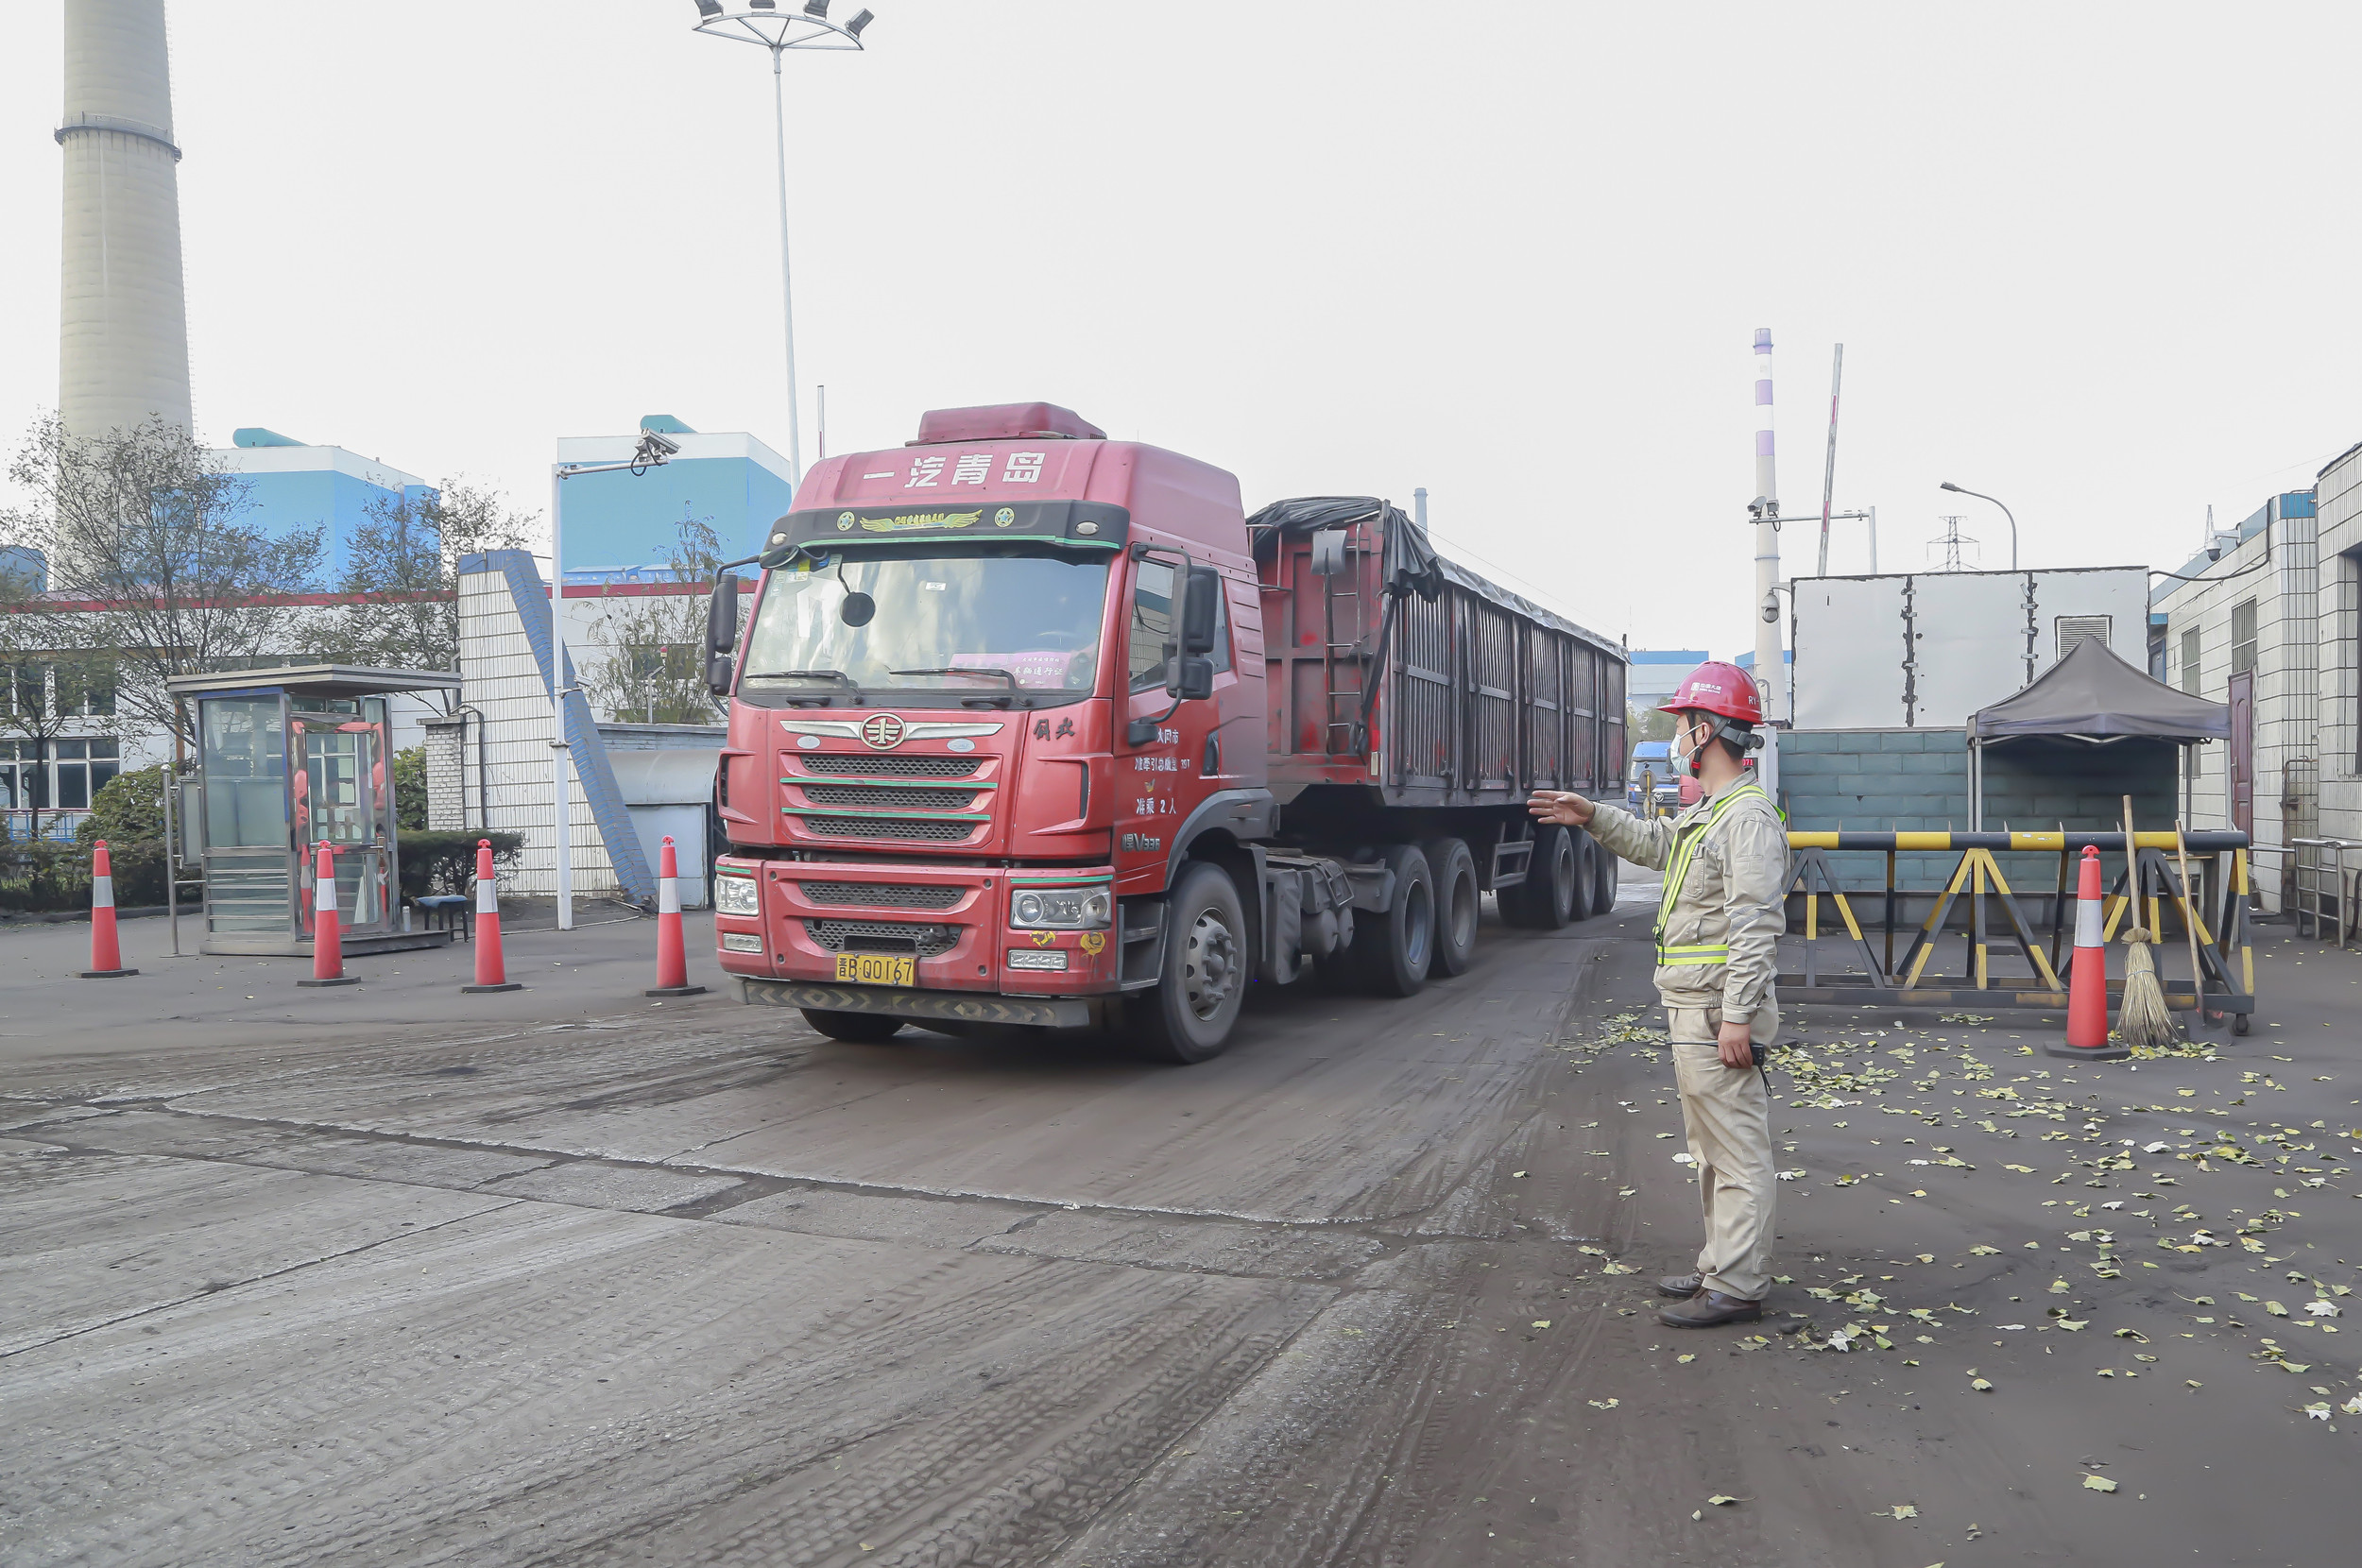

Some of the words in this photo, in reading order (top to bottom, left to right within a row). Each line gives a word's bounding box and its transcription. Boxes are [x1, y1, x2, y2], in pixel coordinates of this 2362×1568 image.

[863, 452, 1046, 488] 一汽青岛
[1013, 666, 1063, 676] 车辆通行证
[1136, 797, 1155, 815] 准乘
[1160, 799, 1166, 813] 2
[1169, 797, 1177, 814] 人
